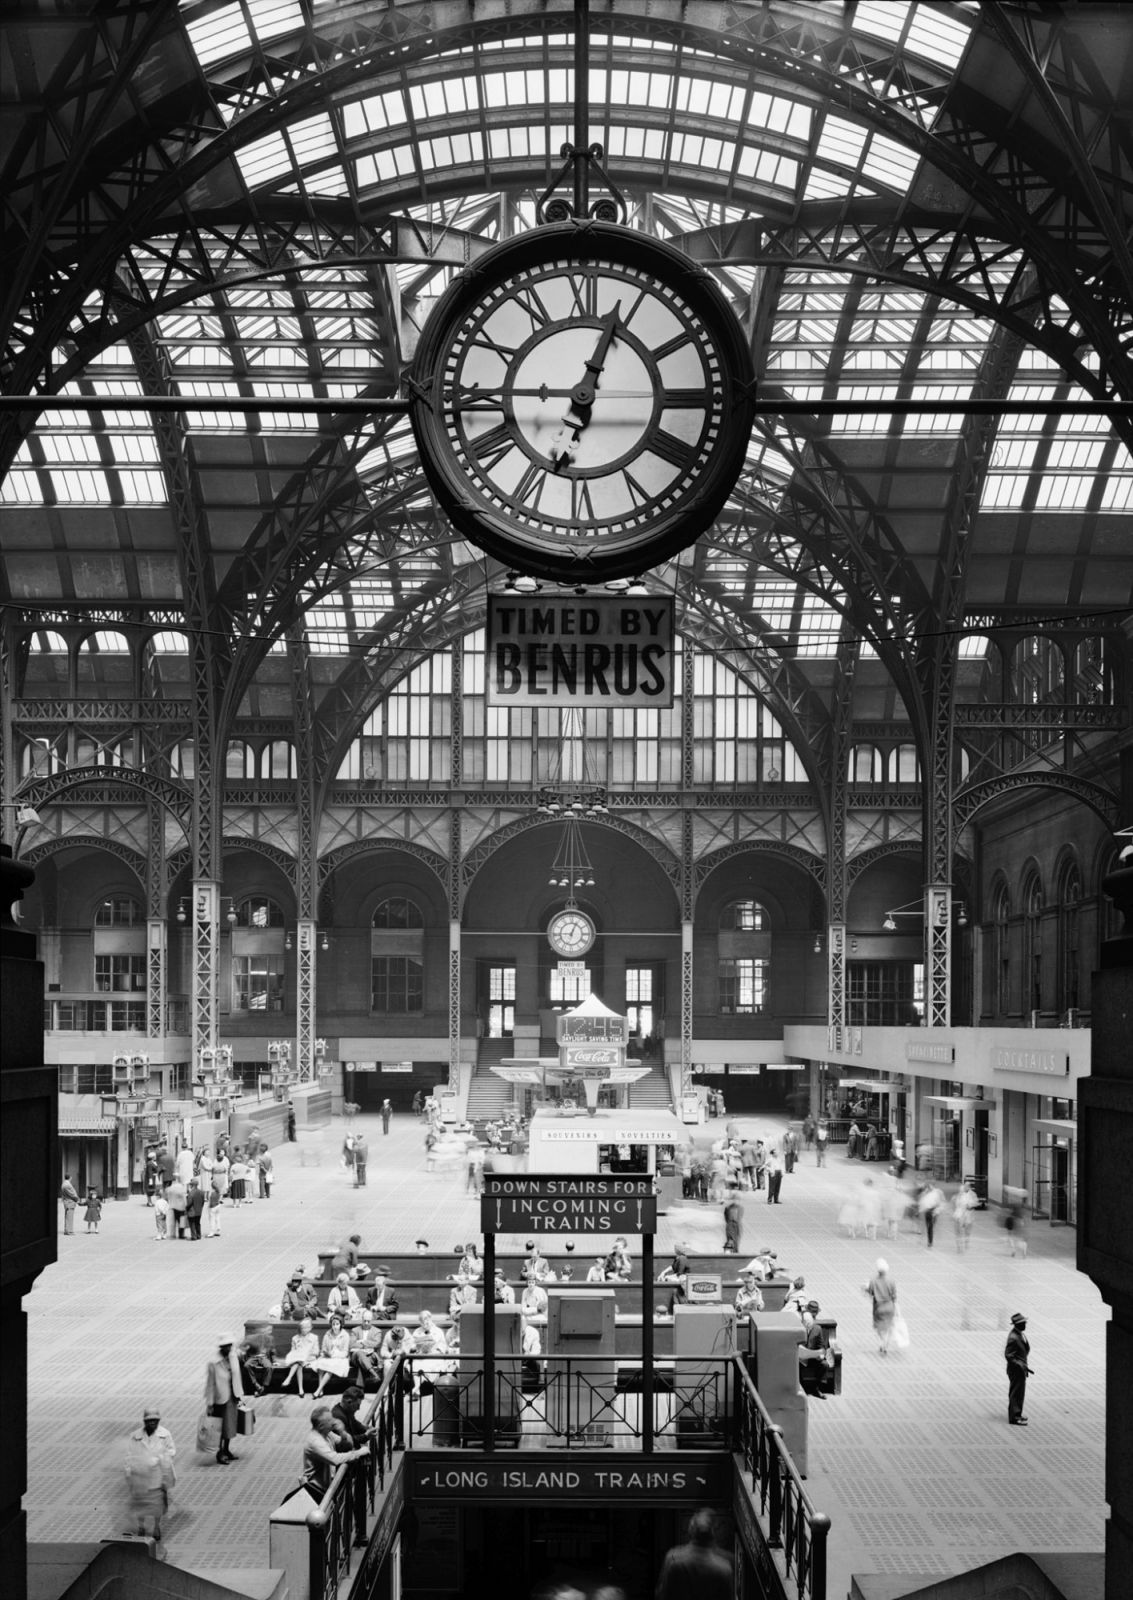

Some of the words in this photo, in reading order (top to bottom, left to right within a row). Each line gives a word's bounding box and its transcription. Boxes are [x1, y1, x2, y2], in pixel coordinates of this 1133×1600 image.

[496, 608, 599, 635] TIMED
[621, 609, 666, 635] BY
[496, 643, 666, 696] BENRUS
[559, 967, 585, 976] BENRUS
[563, 1017, 623, 1036] 12:45
[998, 1051, 1056, 1071] COCKTAILS
[491, 1181, 540, 1193] DOWN
[547, 1181, 608, 1193] STAIRS
[614, 1181, 647, 1194] FOR
[512, 1200, 627, 1213] INCOMING
[530, 1216, 612, 1230] TRAINS
[435, 1471, 489, 1488] LONG
[503, 1471, 580, 1488] ISLAND
[595, 1472, 686, 1488] TRAINS
